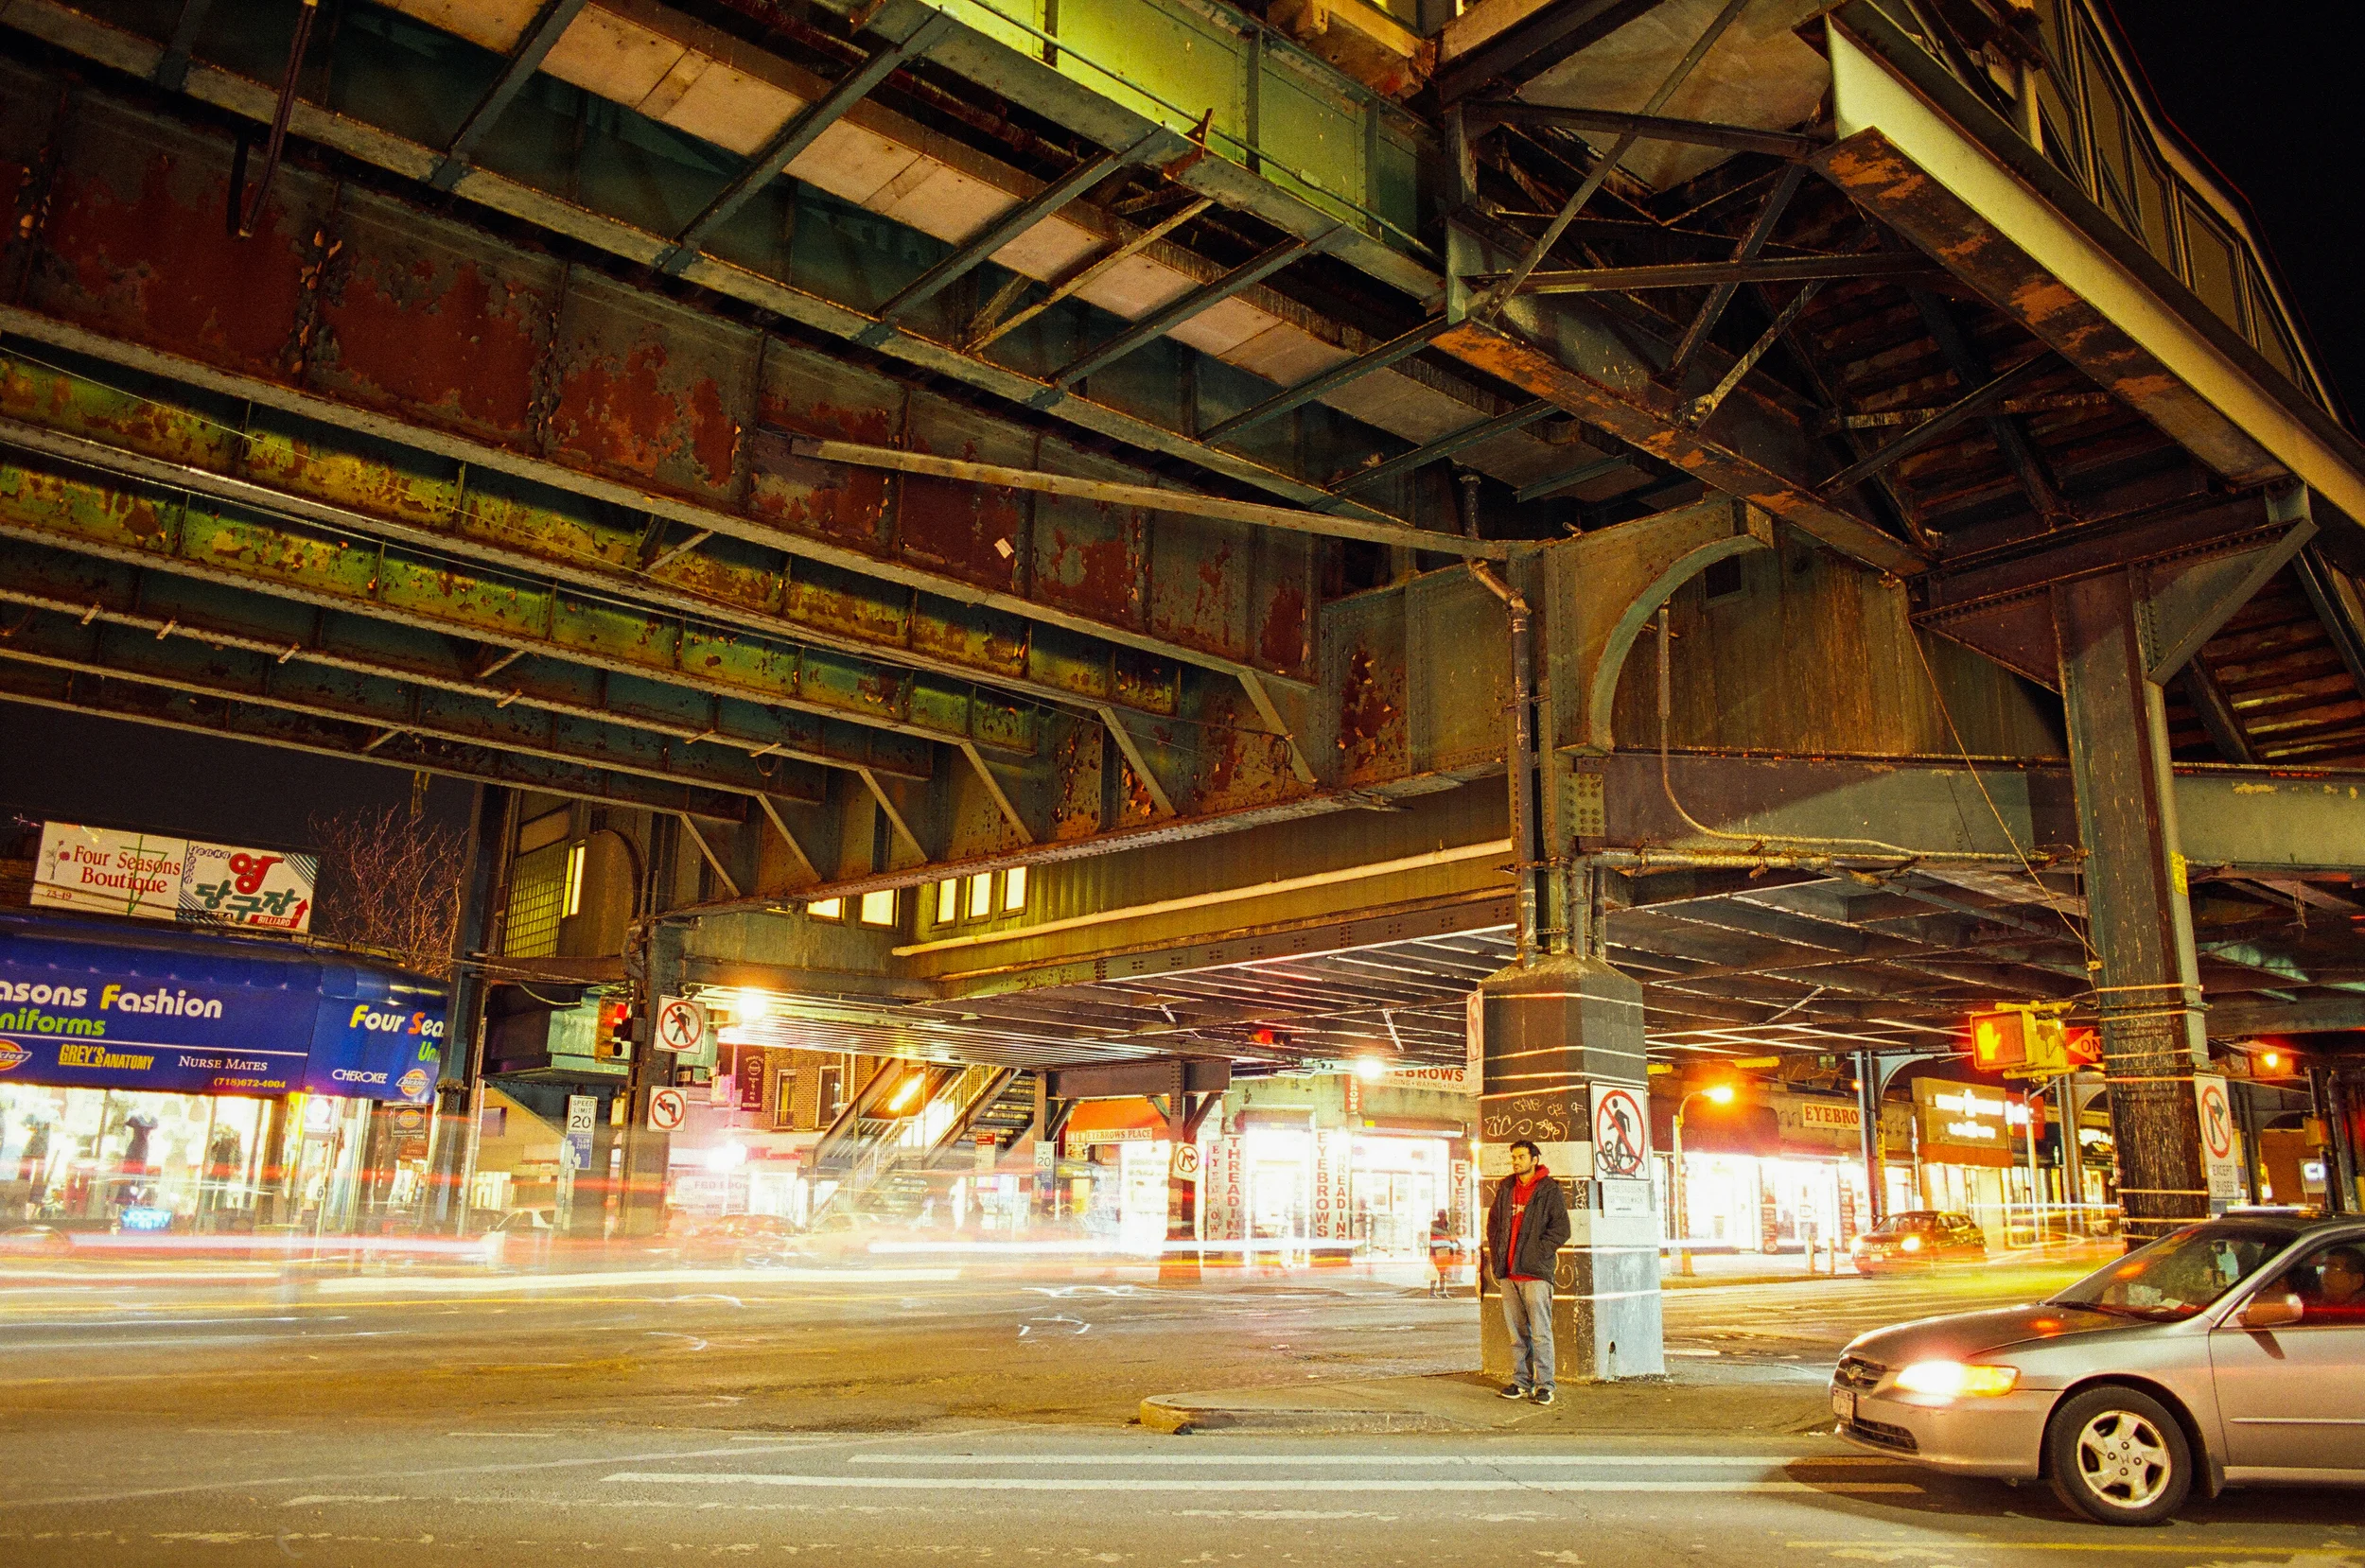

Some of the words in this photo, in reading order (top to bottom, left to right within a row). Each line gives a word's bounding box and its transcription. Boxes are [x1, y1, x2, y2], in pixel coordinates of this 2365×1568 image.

[74, 845, 112, 866] Four
[116, 851, 182, 876] Seasons
[80, 866, 167, 895] Boutique
[256, 916, 291, 928] BILLIARD
[99, 984, 223, 1019] Fashion
[0, 1007, 106, 1037] niforms
[348, 1003, 406, 1033] Four
[59, 1043, 106, 1067] GREY'S
[102, 1055, 154, 1071] ANATOMY
[2080, 1038, 2102, 1053] ON
[178, 1055, 222, 1069] NURSE
[225, 1058, 268, 1071] MATES
[332, 1069, 389, 1085] CHEROKEE
[571, 1115, 591, 1128] 20
[1805, 1106, 1860, 1124] EYEBRO
[1087, 1131, 1126, 1140] EYEBROWS
[1128, 1129, 1151, 1138] PLACE
[1037, 1157, 1051, 1167] 20
[1225, 1137, 1241, 1240] THREADING
[1316, 1132, 1330, 1238] EYEBROWS
[1335, 1153, 1346, 1240] HREADING
